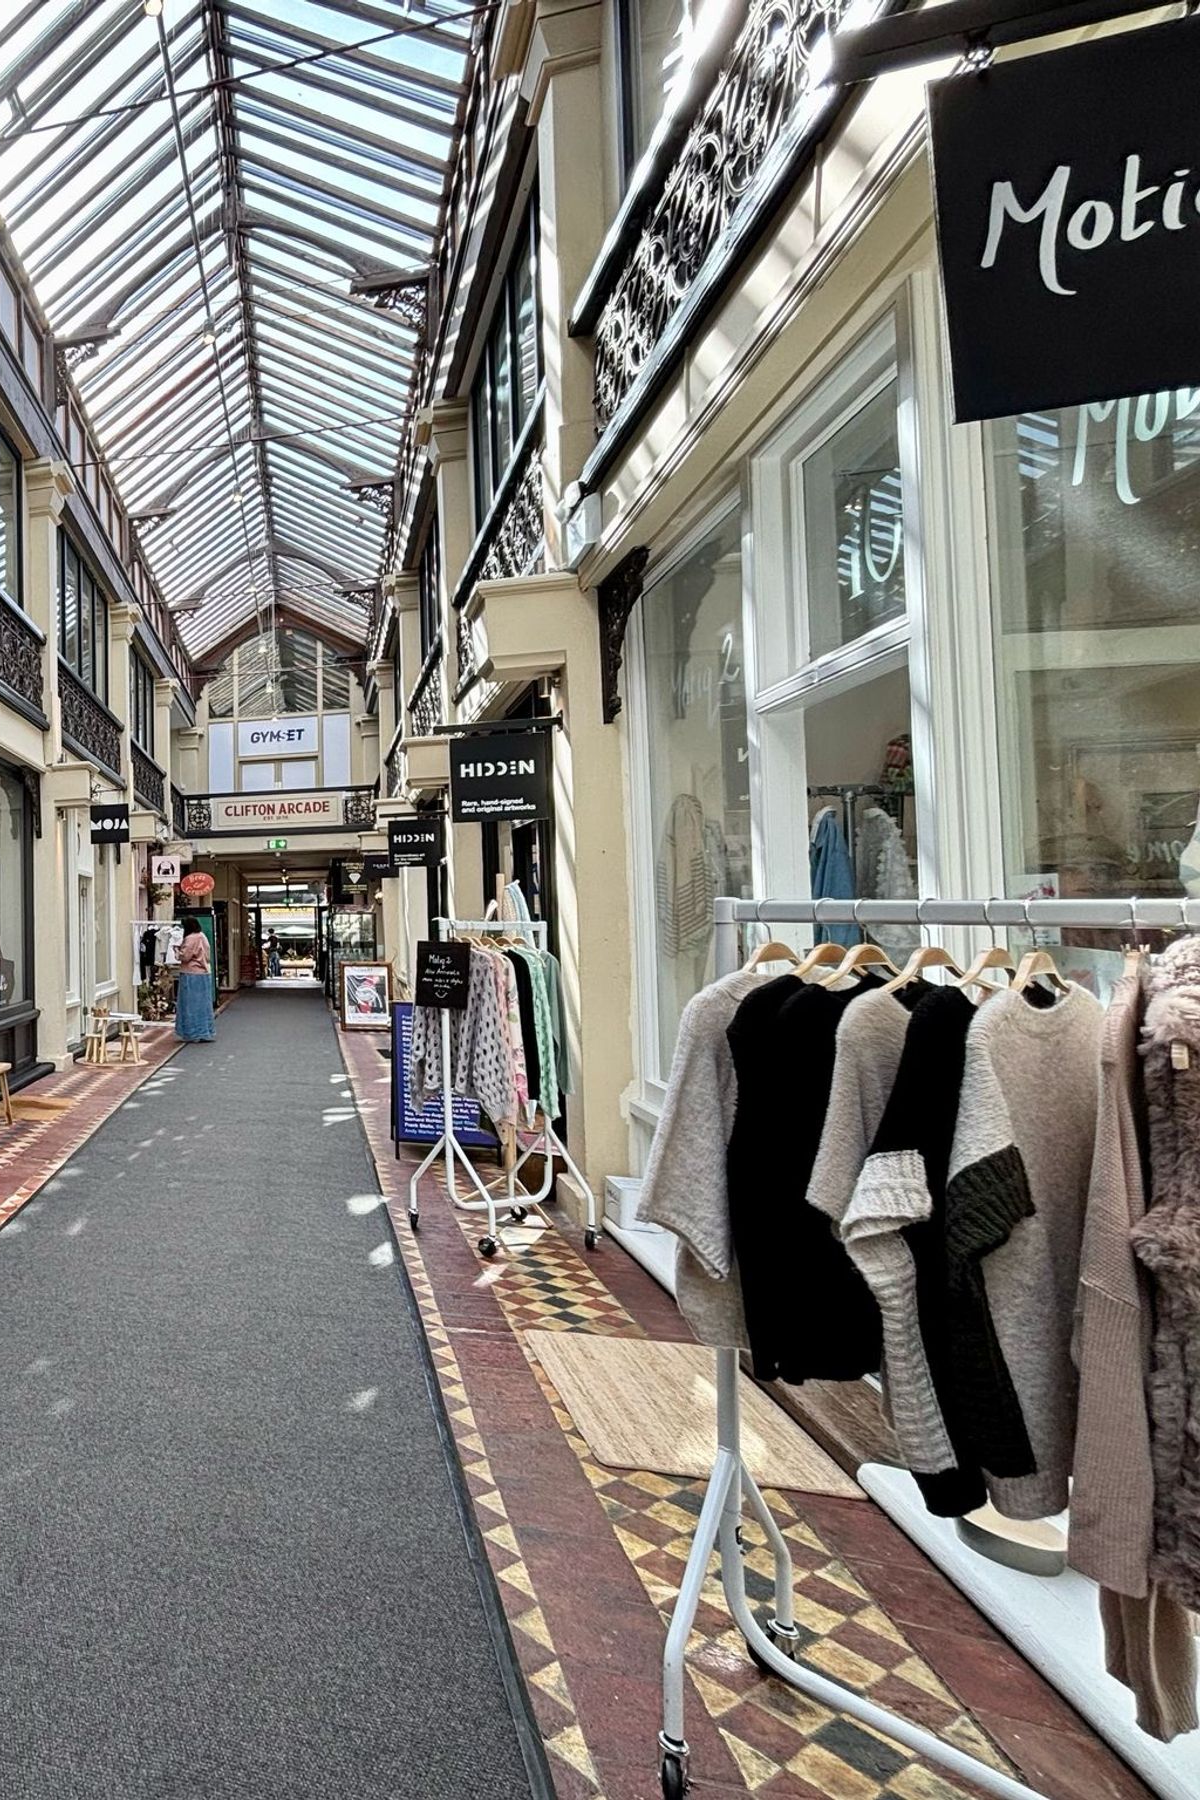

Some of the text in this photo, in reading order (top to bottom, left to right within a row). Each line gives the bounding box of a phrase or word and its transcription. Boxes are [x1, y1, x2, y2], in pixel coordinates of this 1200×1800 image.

[980, 154, 1200, 296] Moti
[460, 759, 536, 779] HIDDEN
[224, 800, 330, 818] CLIFTON ARCADE
[461, 803, 537, 814] and original artworks
[90, 818, 129, 831] MOJA
[393, 832, 435, 844] HIDDEN
